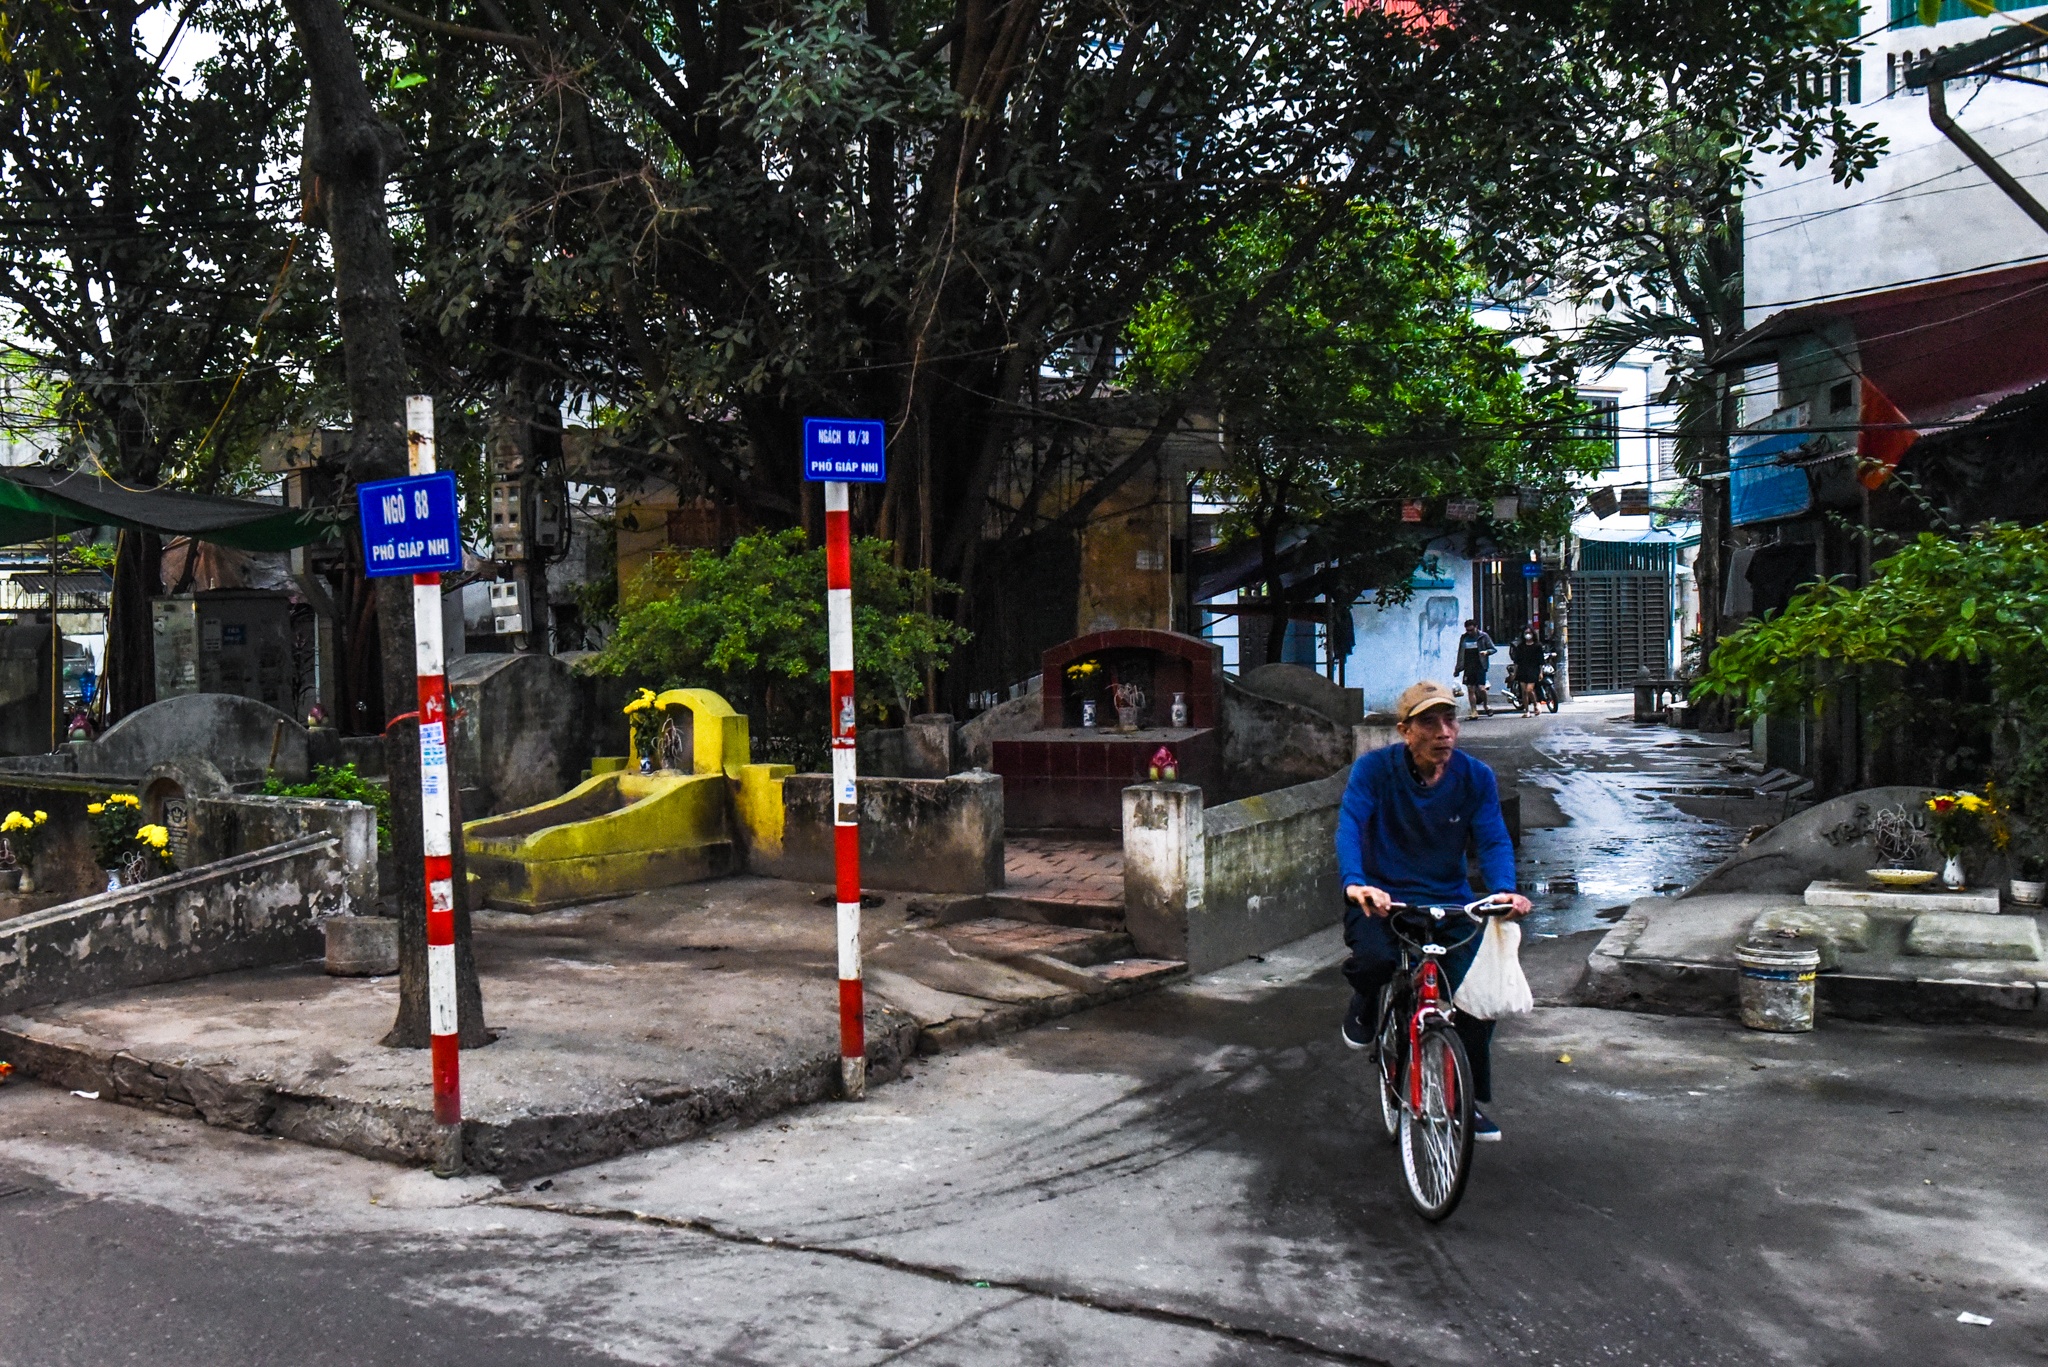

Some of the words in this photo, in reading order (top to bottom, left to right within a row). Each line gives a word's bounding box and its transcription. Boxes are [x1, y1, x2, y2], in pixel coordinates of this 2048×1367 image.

[818, 426, 842, 444] NGÁCH
[811, 457, 833, 472] PHỐ
[835, 459, 859, 472] GIÁP
[861, 462, 879, 476] NHỊ
[414, 489, 430, 520] 88
[372, 537, 395, 561] PHỐ
[397, 536, 425, 559] GIÁP
[427, 538, 450, 559] NHỊ
